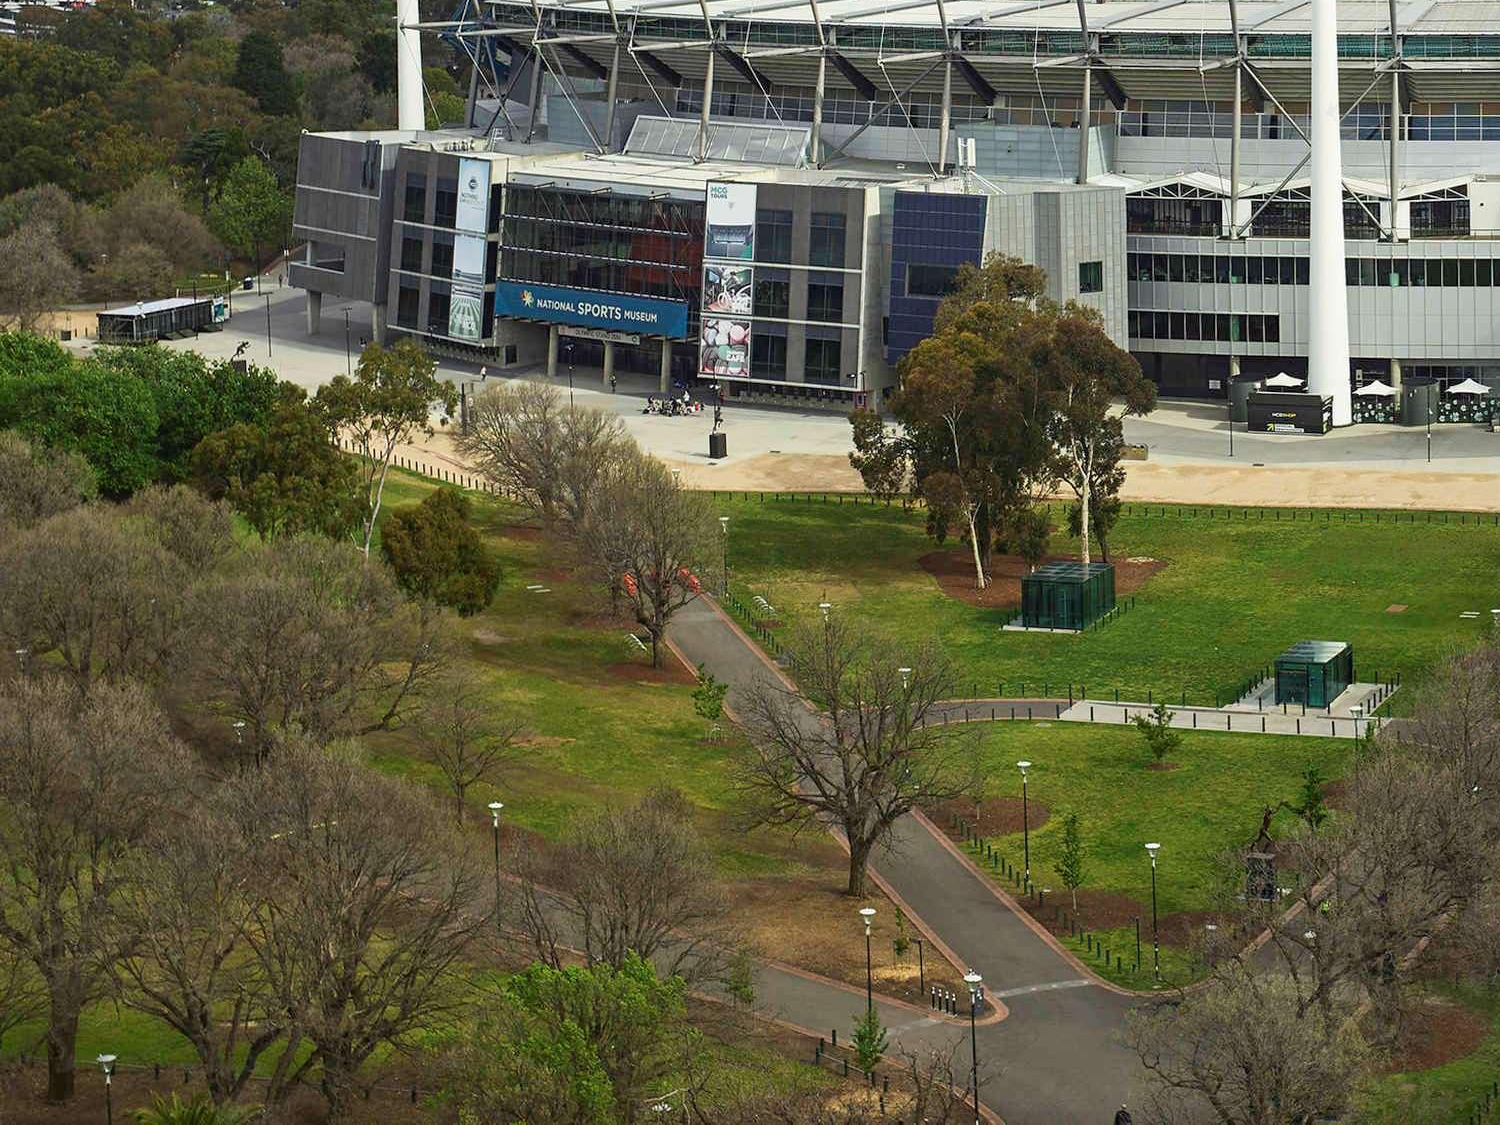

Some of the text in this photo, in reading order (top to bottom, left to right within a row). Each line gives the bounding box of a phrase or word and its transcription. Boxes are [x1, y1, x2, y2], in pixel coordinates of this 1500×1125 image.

[710, 186, 728, 194] MCG
[537, 299, 657, 323] NATIONAL SPORTS MUSEUM
